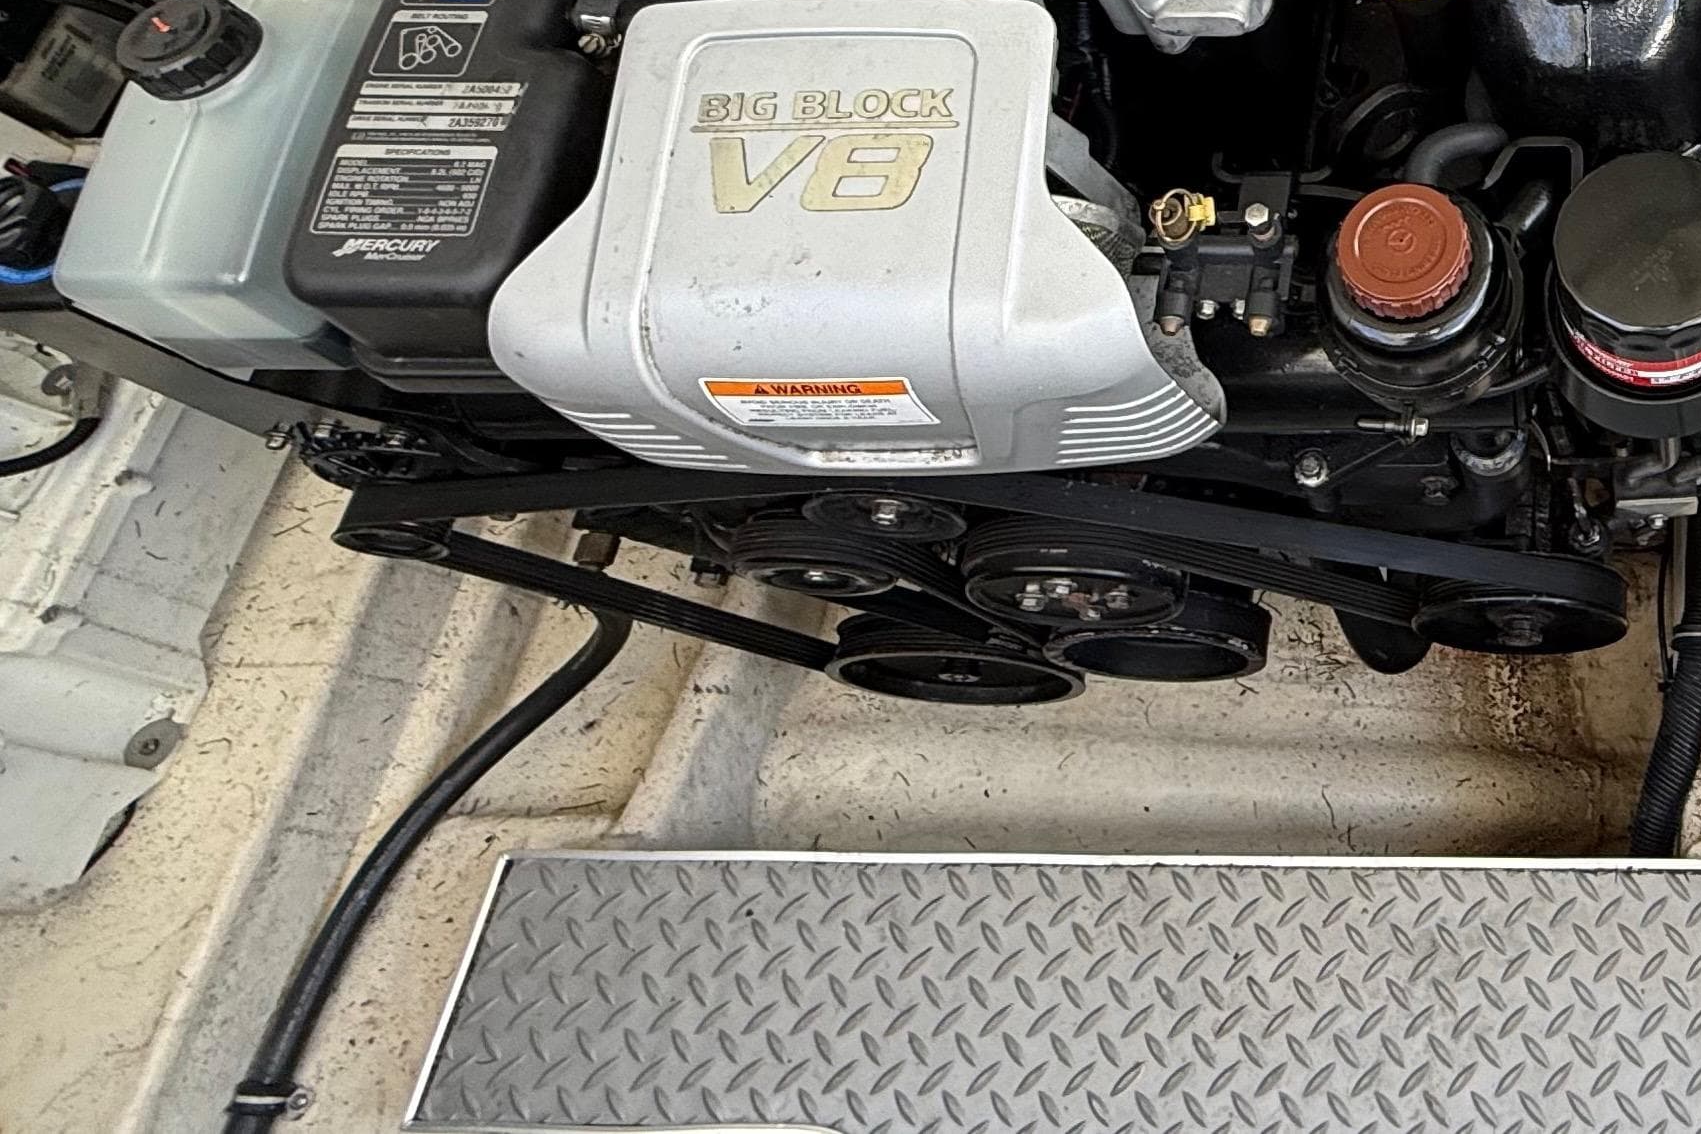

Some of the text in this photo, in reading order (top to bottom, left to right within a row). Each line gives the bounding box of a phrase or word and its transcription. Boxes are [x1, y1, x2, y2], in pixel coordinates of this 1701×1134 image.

[697, 88, 954, 123] BIG BLOCK
[709, 133, 934, 214] V8
[334, 238, 440, 256] MERCURY
[770, 384, 863, 395] WARNING
